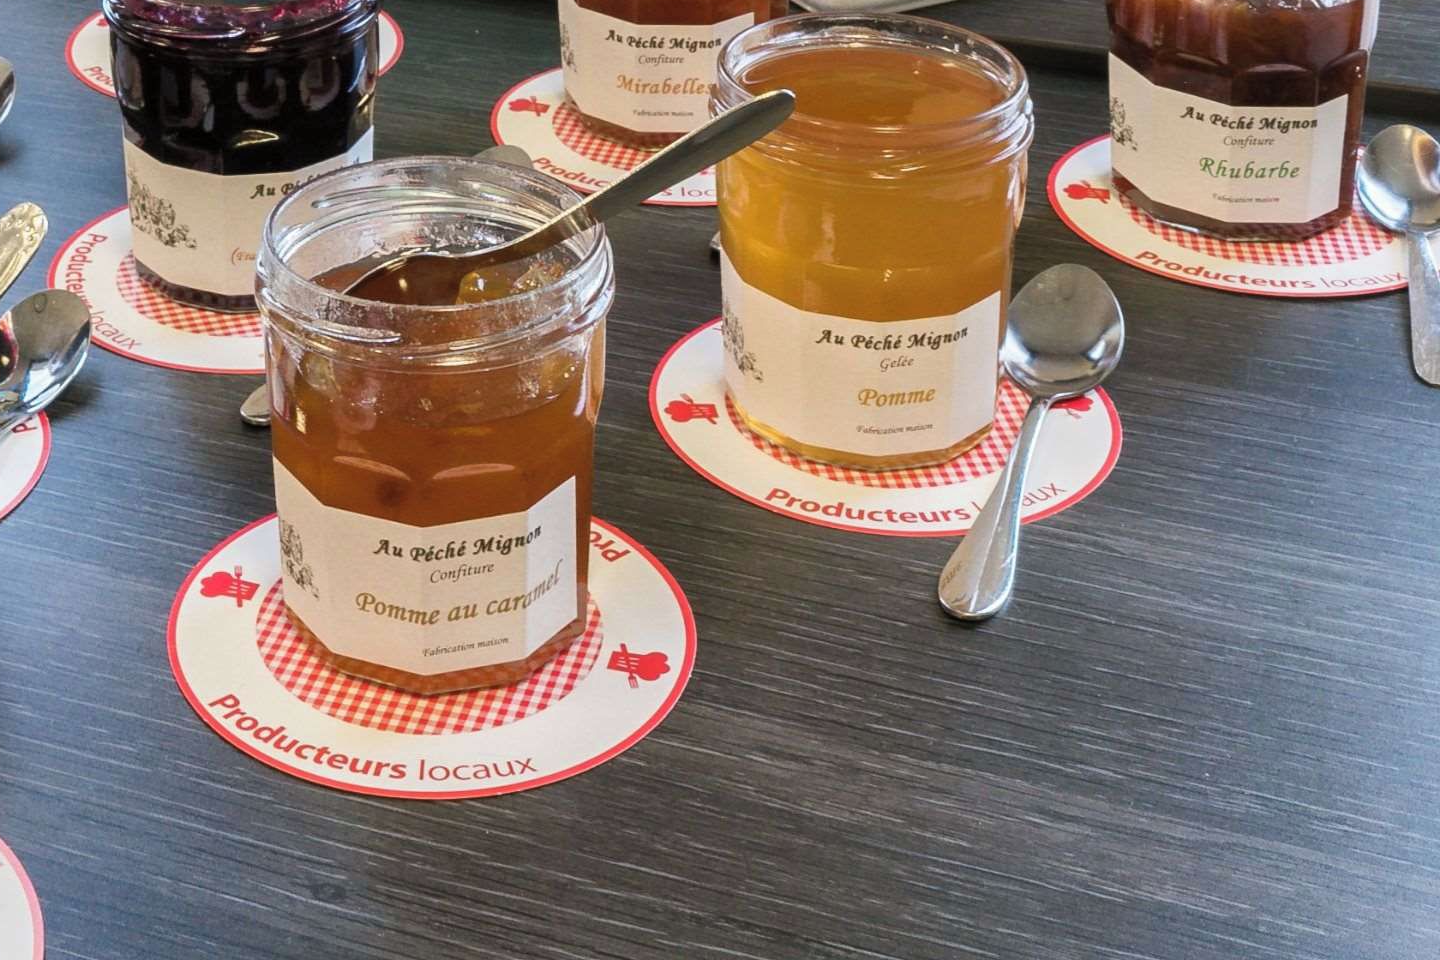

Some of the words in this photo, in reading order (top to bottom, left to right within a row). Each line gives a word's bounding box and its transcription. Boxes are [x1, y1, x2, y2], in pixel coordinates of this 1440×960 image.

[605, 29, 623, 43] Au
[626, 35, 665, 49] Péché
[669, 37, 722, 53] Mignon
[637, 54, 685, 67] Confiture
[1180, 106, 1205, 122] Au
[1210, 113, 1254, 130] Péché
[1258, 116, 1318, 134] Mignon
[1223, 135, 1275, 149] Confiture
[1199, 157, 1301, 179] Rhubarbe
[250, 184, 275, 199] Au
[1135, 250, 1317, 290] Producteurs
[1322, 271, 1408, 290] locaux
[816, 328, 844, 346] Au
[851, 333, 902, 351] Péché
[907, 326, 969, 350] Mignon
[880, 355, 915, 373] Gelée
[858, 387, 937, 408] Pomme
[856, 424, 904, 436] Fabrication
[905, 423, 933, 432] maison
[765, 487, 970, 524] Producteurs
[970, 482, 1068, 515] laux
[373, 538, 404, 559] Au
[410, 538, 467, 564] Péché
[473, 524, 542, 557] Mignon
[430, 562, 495, 584] Confiture
[355, 592, 441, 626] Pomme
[447, 604, 478, 622] au
[486, 559, 564, 616] caramel
[422, 642, 476, 658] Fabrication
[477, 636, 510, 649] maison
[208, 693, 408, 780] Producteurs
[419, 757, 538, 782] locaux
